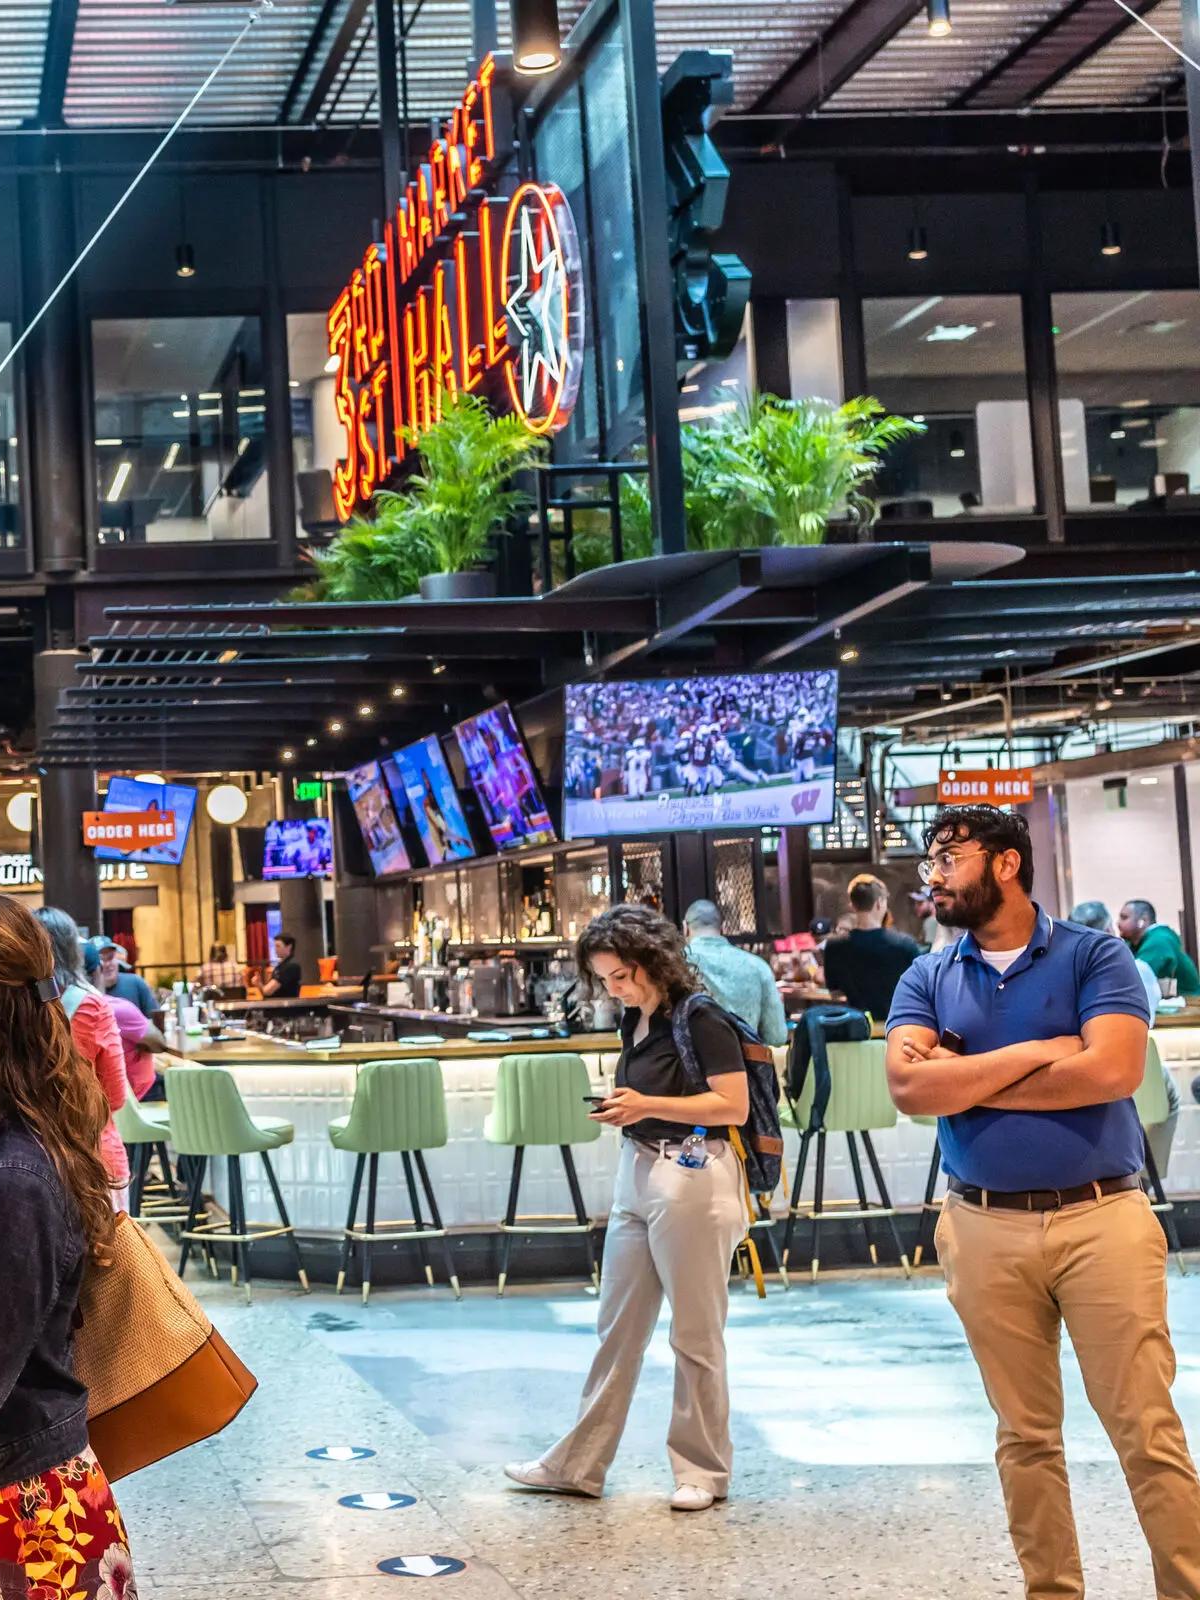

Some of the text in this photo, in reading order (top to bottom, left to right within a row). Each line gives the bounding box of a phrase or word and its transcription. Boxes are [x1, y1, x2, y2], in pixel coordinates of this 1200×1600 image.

[398, 51, 496, 284] MARKET
[404, 198, 510, 448] HALL
[87, 823, 174, 840] ORDER HERE
[941, 781, 1030, 796] ORDER HERE
